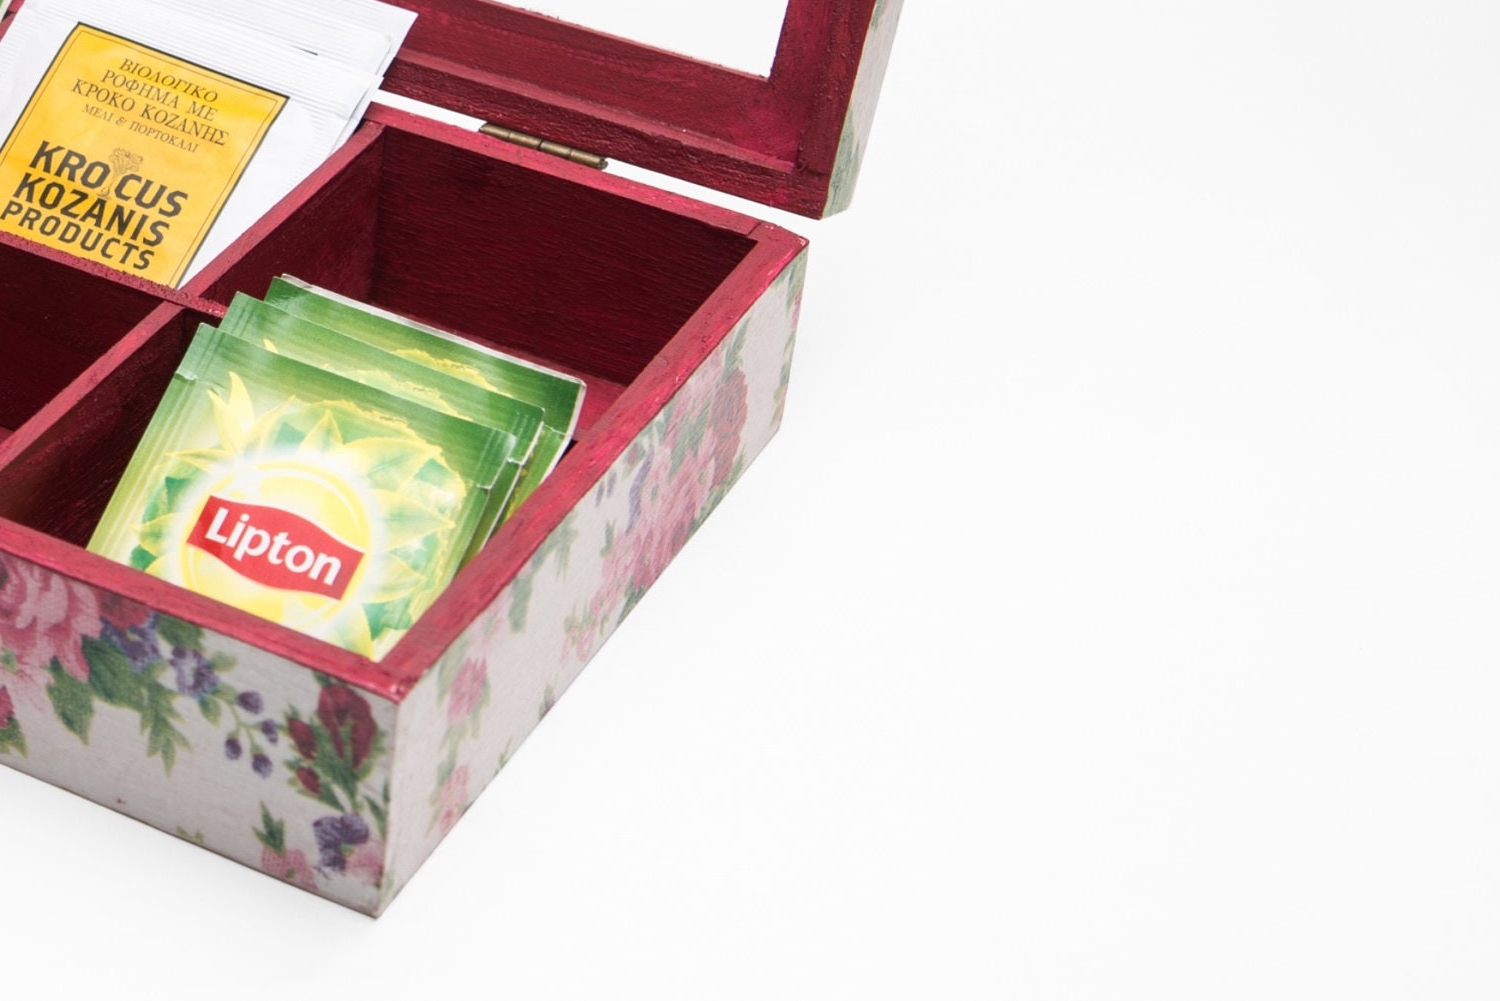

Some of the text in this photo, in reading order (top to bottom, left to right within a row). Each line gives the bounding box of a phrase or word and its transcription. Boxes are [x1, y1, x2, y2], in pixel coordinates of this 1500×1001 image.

[71, 80, 229, 146] ΚΡΟΚΟ ΚΟΖΑΝΗΣ
[101, 70, 218, 121] ΡΟΦΗΜΑ ΜΕ
[119, 58, 218, 103] ΒΙΟΛΟΓΙΚΟ
[0, 201, 155, 271] PRODUCTS
[12, 173, 170, 247] KOZANIS
[205, 507, 342, 585] Lipton
